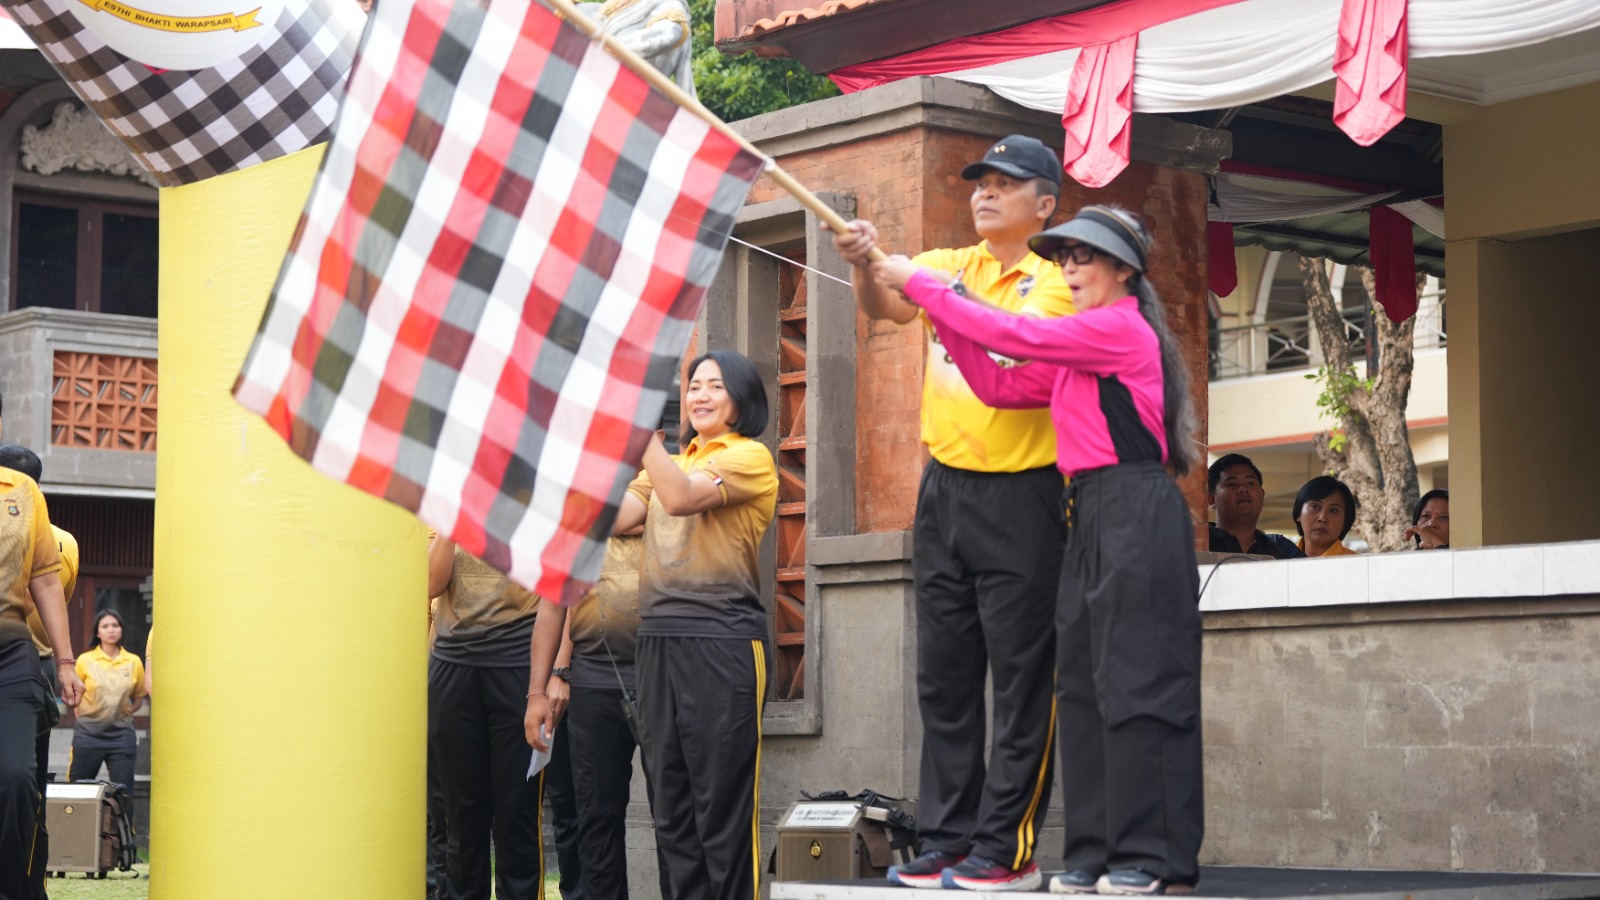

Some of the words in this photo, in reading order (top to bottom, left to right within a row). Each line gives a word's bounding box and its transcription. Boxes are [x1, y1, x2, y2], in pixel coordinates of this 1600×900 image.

[104, 1, 131, 17] ESTHI
[135, 14, 171, 27] BHAKTI
[175, 17, 232, 28] WARAPSARI
